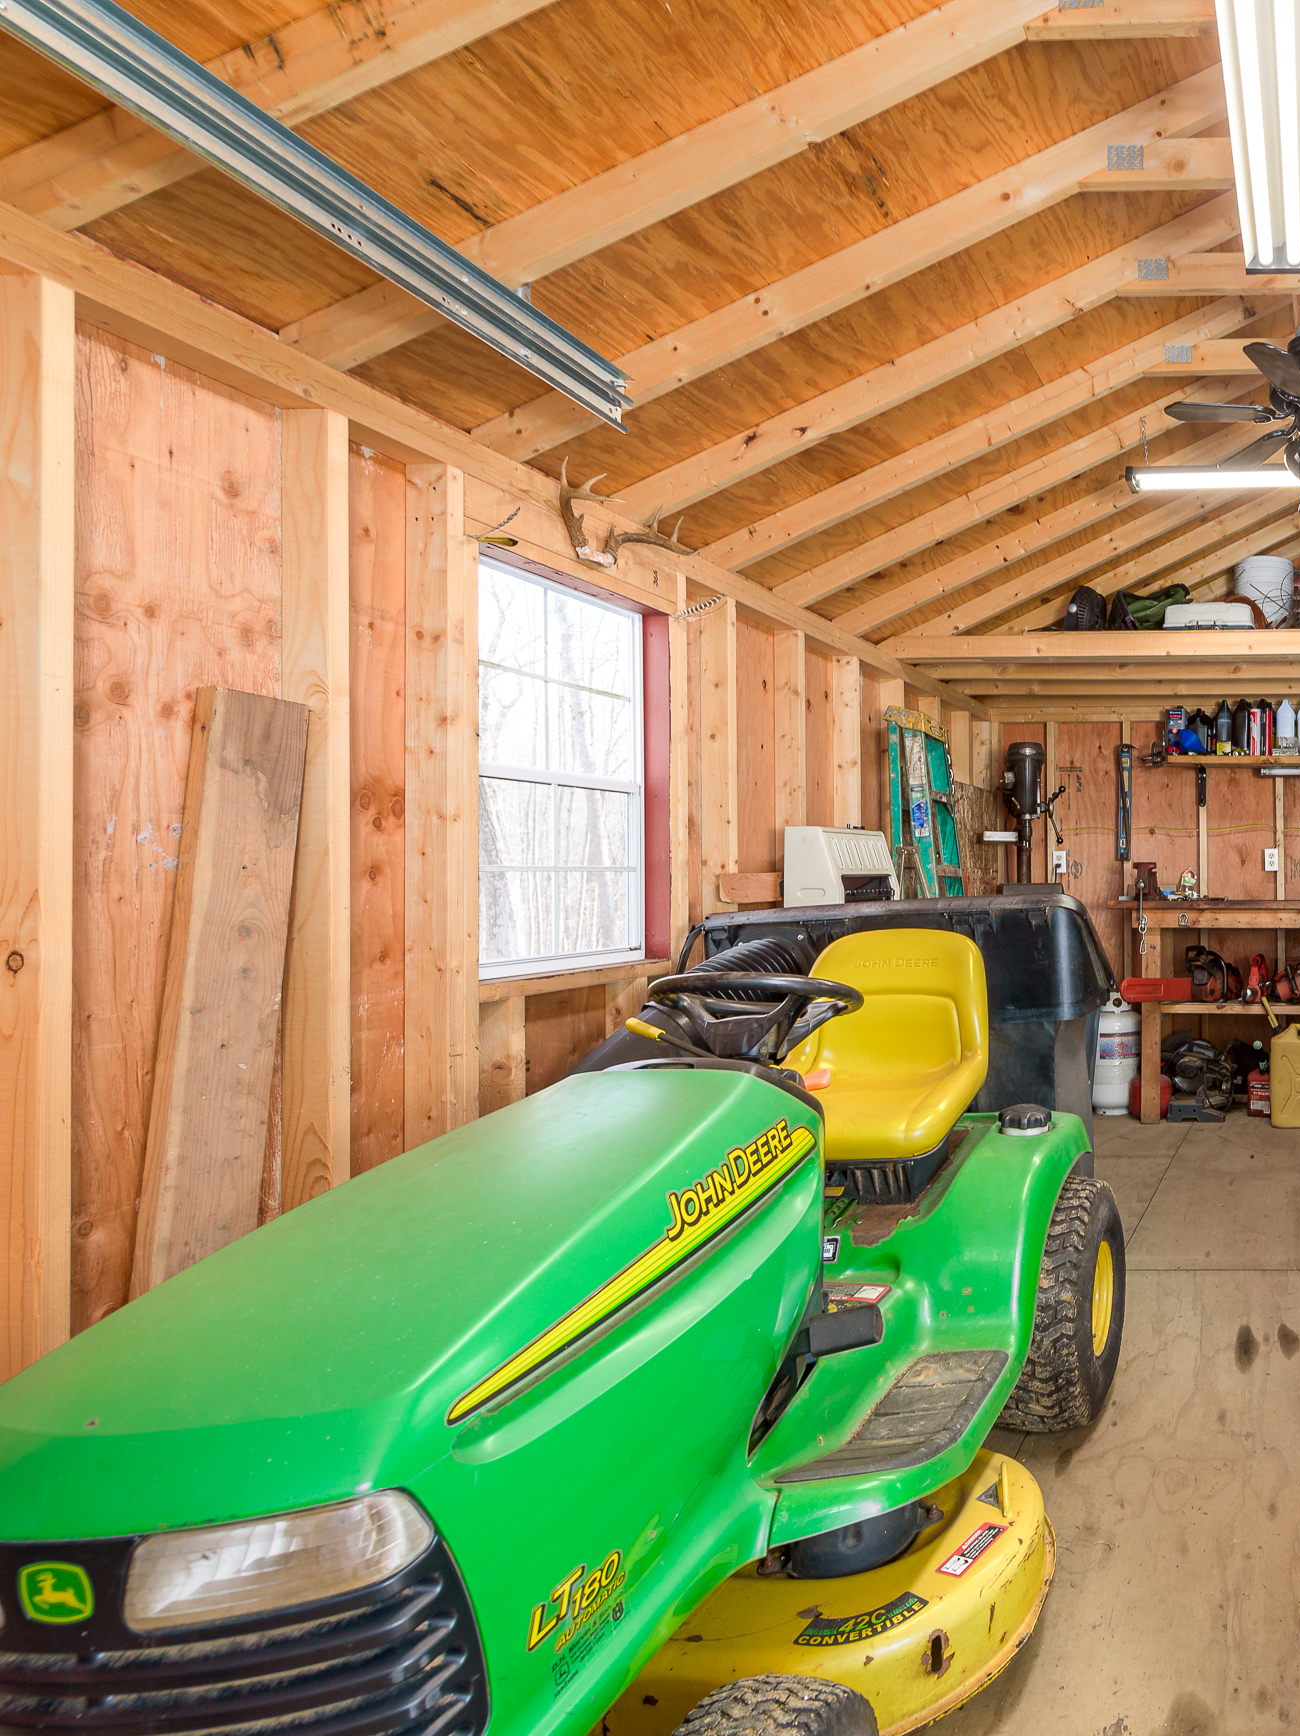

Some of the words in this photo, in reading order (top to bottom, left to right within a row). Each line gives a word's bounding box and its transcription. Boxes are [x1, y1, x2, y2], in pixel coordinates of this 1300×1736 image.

[853, 957, 891, 969] JOHN
[893, 957, 938, 968] DEERE
[667, 1163, 736, 1242] JOHN
[727, 1118, 793, 1190] DEERE
[555, 1571, 626, 1653] AUTOMATIC
[797, 1600, 925, 1645] CONVERTIBLE
[838, 1609, 886, 1633] 42C
